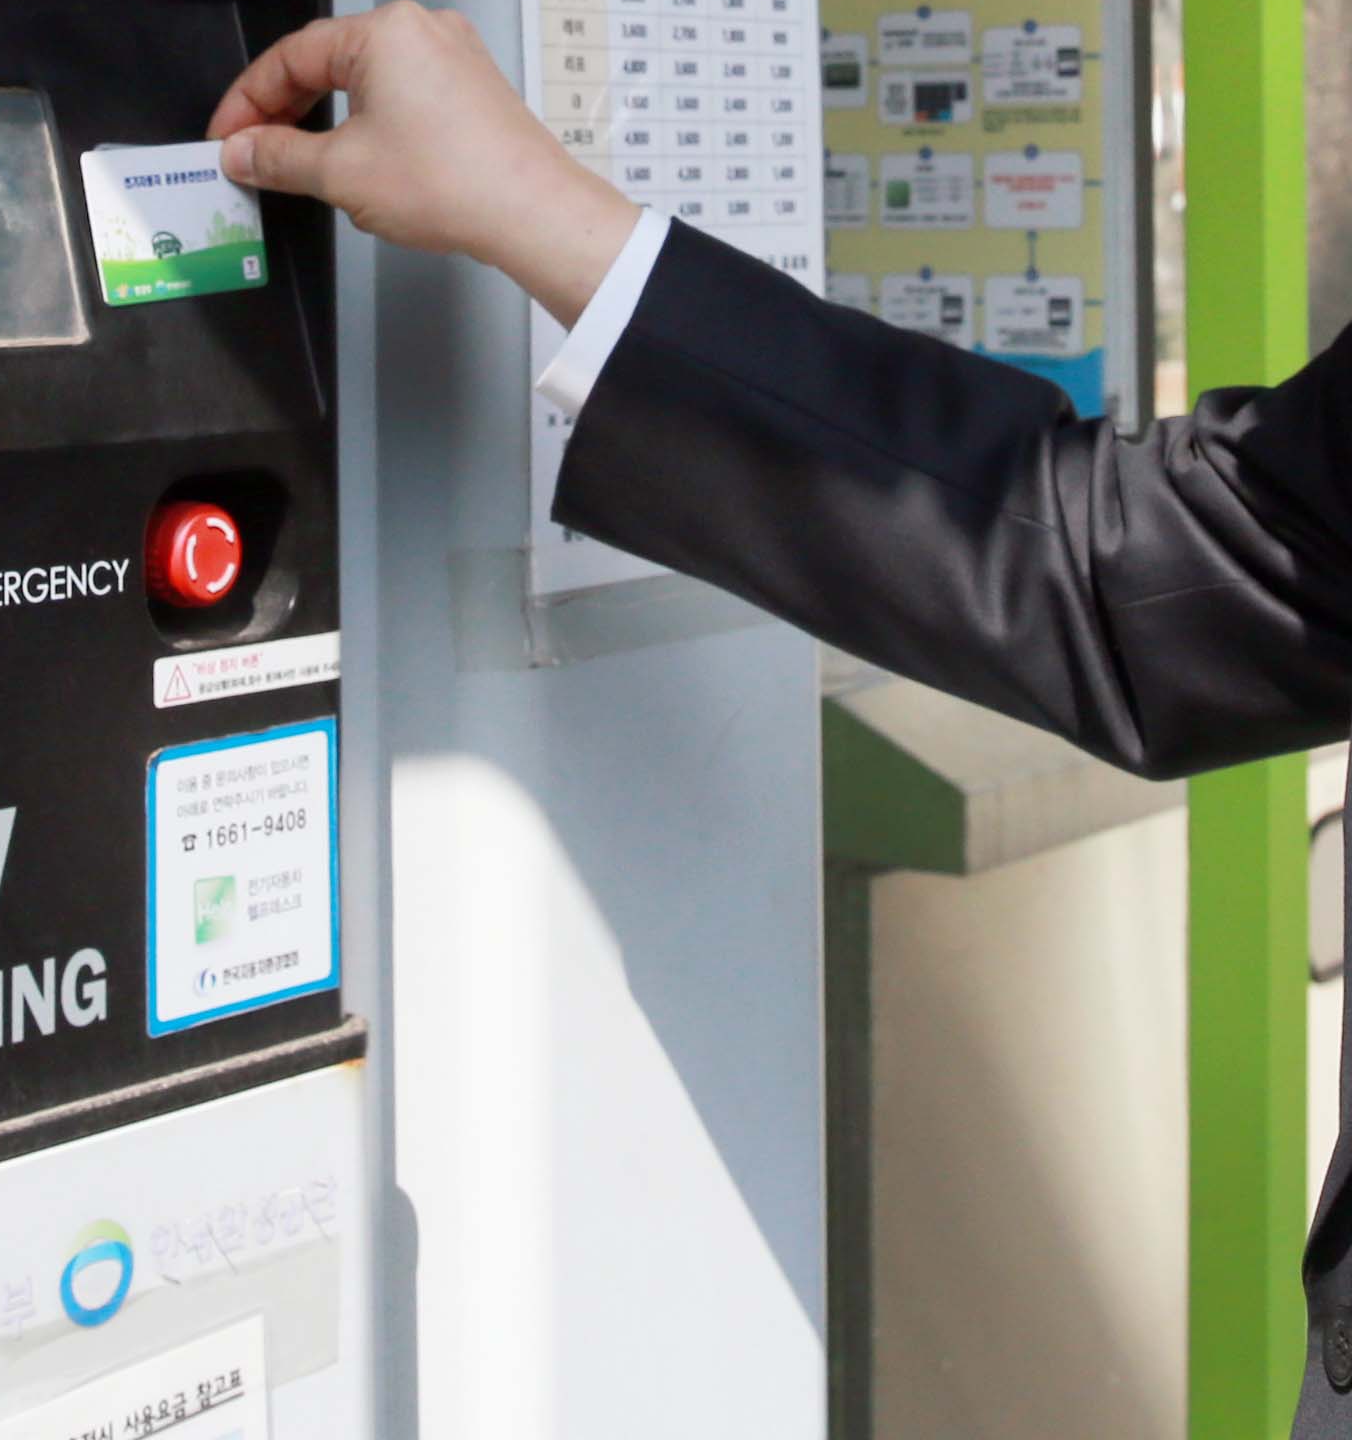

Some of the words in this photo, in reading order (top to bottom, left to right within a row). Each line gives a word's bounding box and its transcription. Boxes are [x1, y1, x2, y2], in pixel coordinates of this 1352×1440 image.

[206, 807, 308, 849] 1661-9408
[122, 1391, 188, 1436] 사용요금
[196, 1368, 245, 1411] 참고표
